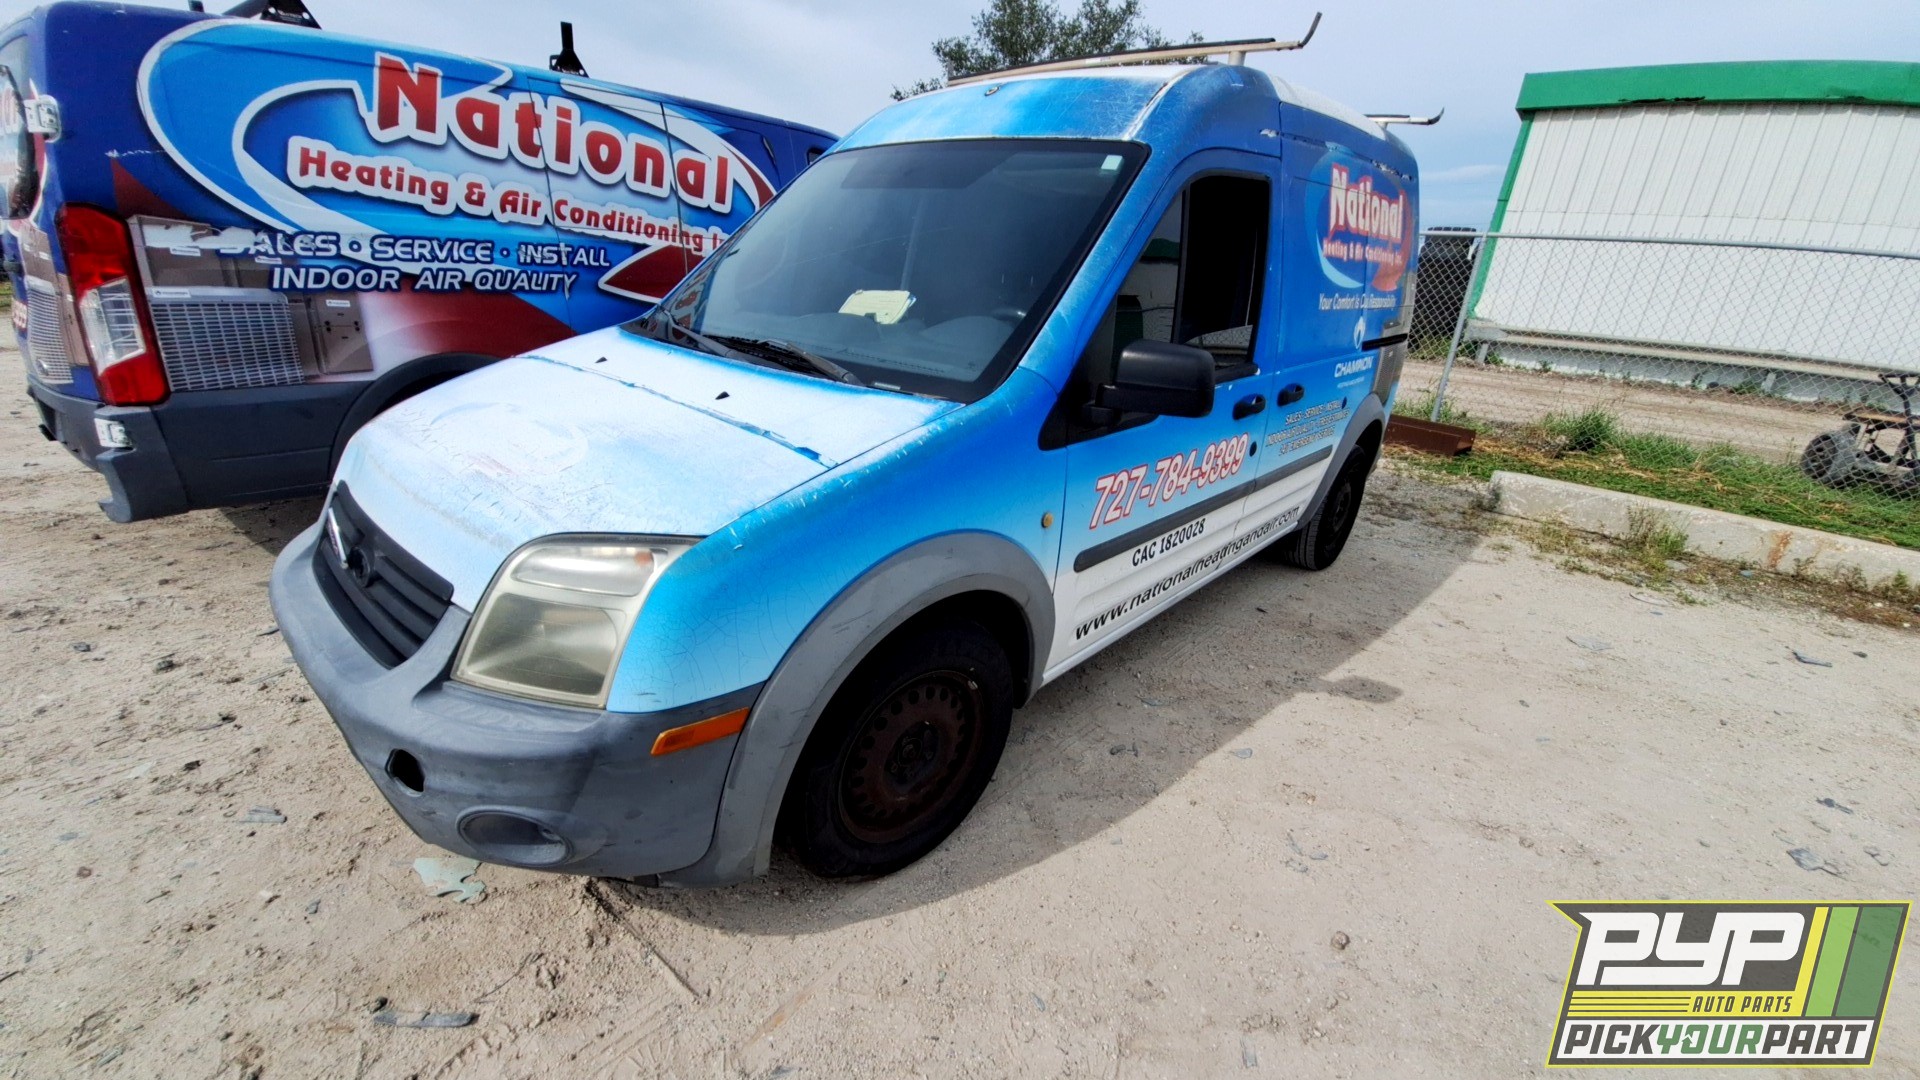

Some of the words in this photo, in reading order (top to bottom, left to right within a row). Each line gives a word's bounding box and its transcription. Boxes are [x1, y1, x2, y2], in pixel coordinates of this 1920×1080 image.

[376, 55, 729, 205] National
[299, 146, 449, 206] Heating
[464, 181, 486, 207] &
[500, 189, 542, 218] Air
[554, 199, 704, 252] Conditioning
[1329, 166, 1404, 240] National
[219, 231, 338, 256] ALES
[373, 237, 494, 263] SERVICE
[519, 243, 610, 267] INSTALL
[1323, 238, 1347, 262] Heating
[272, 267, 400, 290] INDOOR
[414, 270, 463, 290] AIR
[474, 271, 577, 291] QUALITY
[1319, 293, 1332, 311] Your
[1333, 293, 1354, 310] Comfort
[1089, 432, 1249, 530] 727-784-9399
[1075, 507, 1300, 641] www.nationalheatingandair.com
[1132, 543, 1157, 567] CAC
